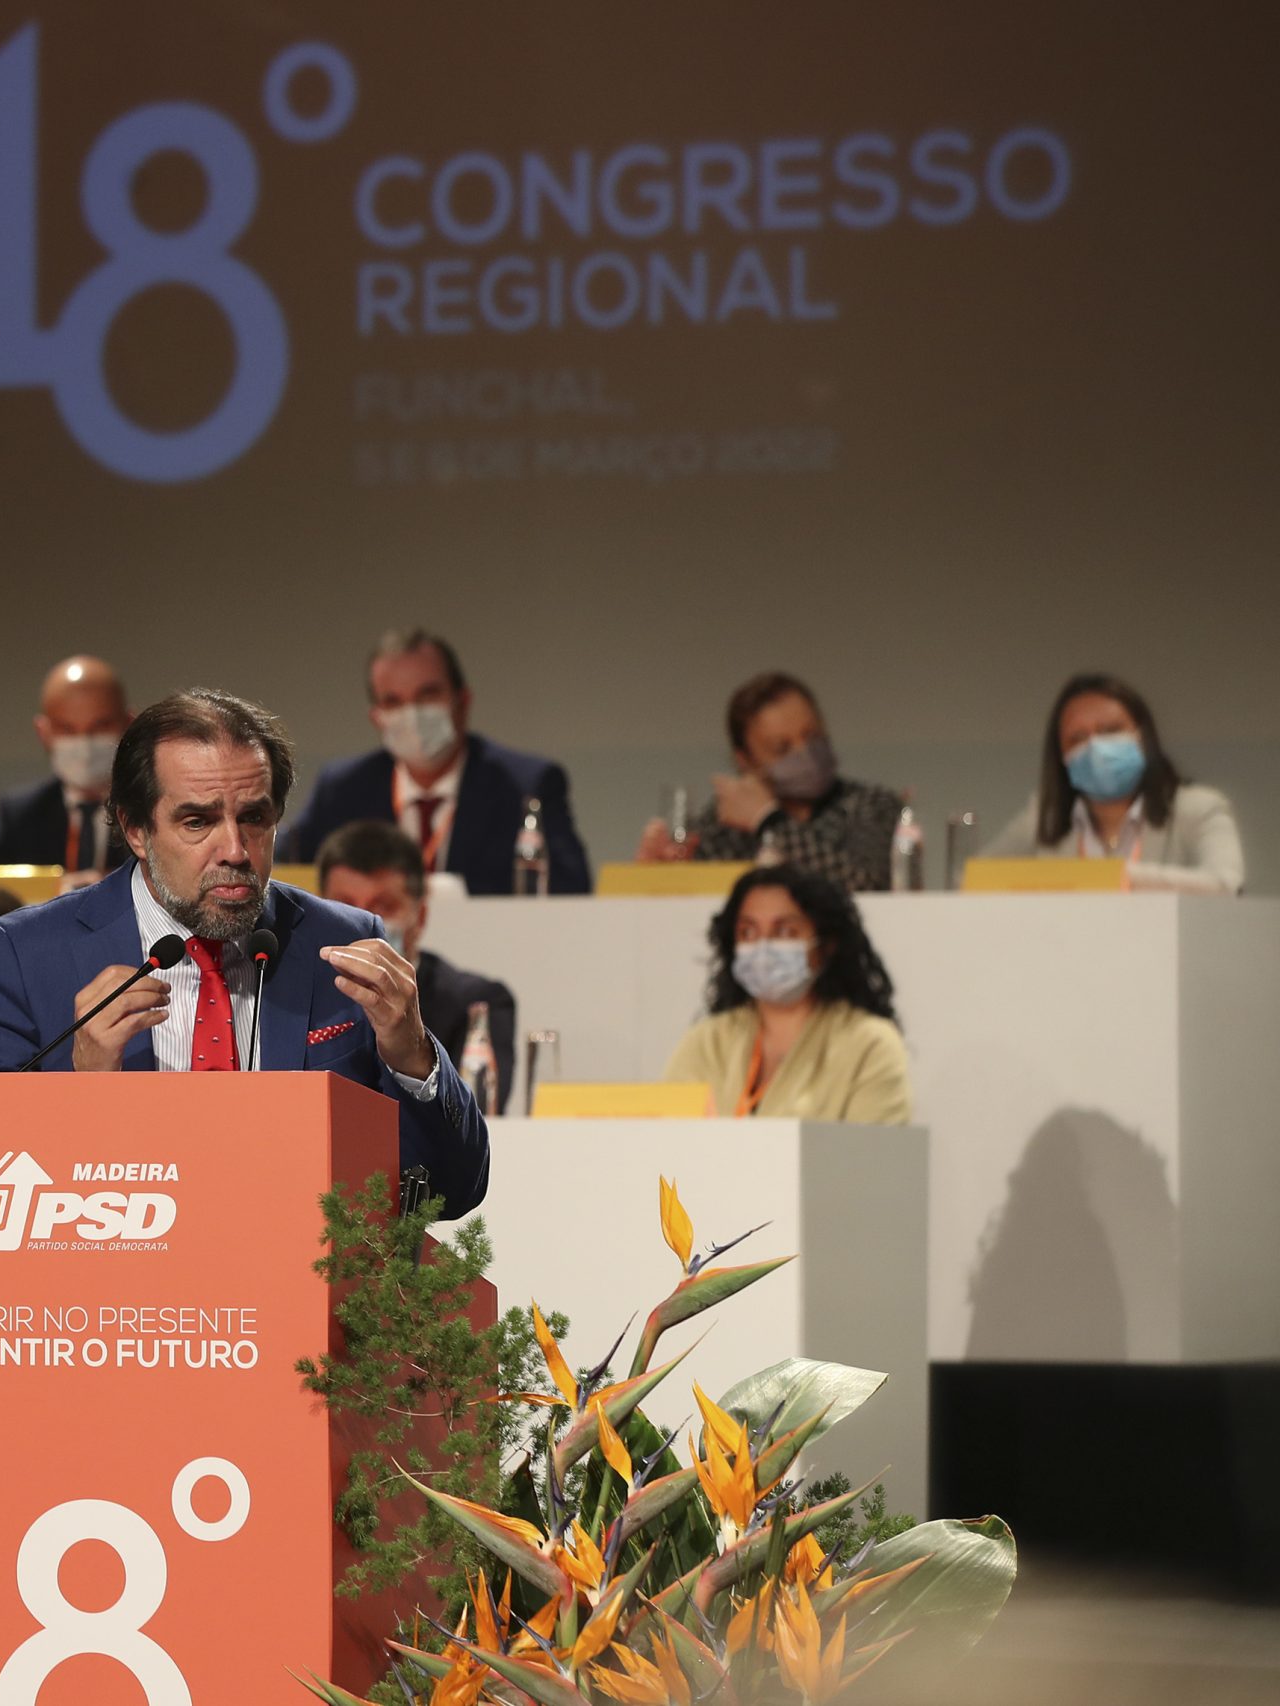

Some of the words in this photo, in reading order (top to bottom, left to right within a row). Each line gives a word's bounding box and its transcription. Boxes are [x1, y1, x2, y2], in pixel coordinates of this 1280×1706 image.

[355, 128, 1072, 248] CONGRESSO
[358, 249, 839, 335] REGIONAL
[72, 1163, 179, 1182] MADEIRA
[29, 1191, 177, 1241] PSD
[27, 1241, 68, 1251] PARTIDO
[71, 1241, 105, 1251] SOCIAL
[108, 1241, 168, 1251] DEMOCRATA
[43, 1306, 89, 1333] NO
[99, 1306, 258, 1334] PRESENTE
[81, 1338, 108, 1368] O
[116, 1338, 259, 1369] FUTURO
